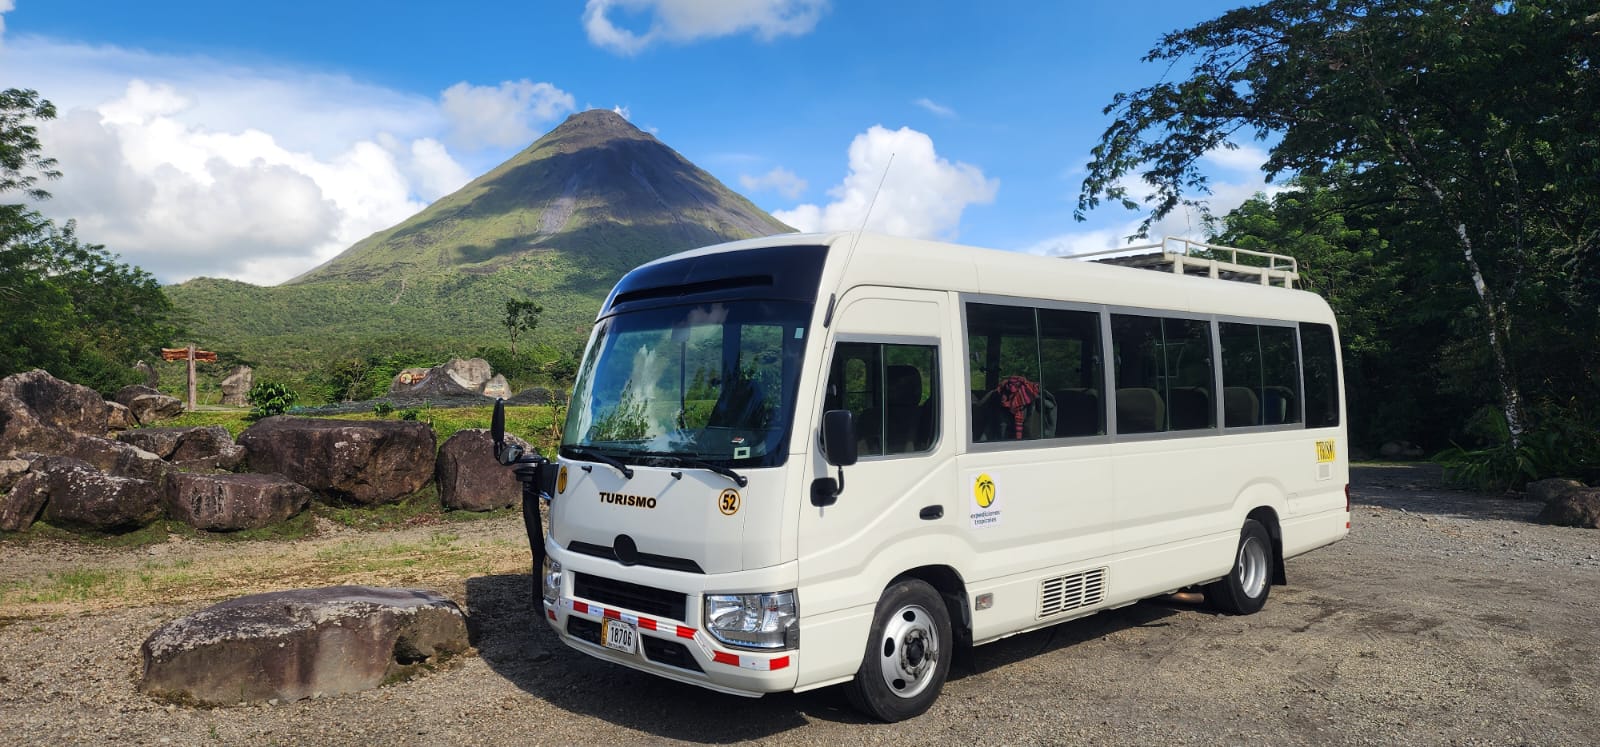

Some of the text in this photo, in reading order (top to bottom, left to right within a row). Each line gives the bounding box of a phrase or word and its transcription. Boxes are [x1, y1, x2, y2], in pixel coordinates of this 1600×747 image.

[599, 491, 657, 509] TURISMO
[722, 494, 736, 510] 52
[611, 626, 632, 647] 18706
